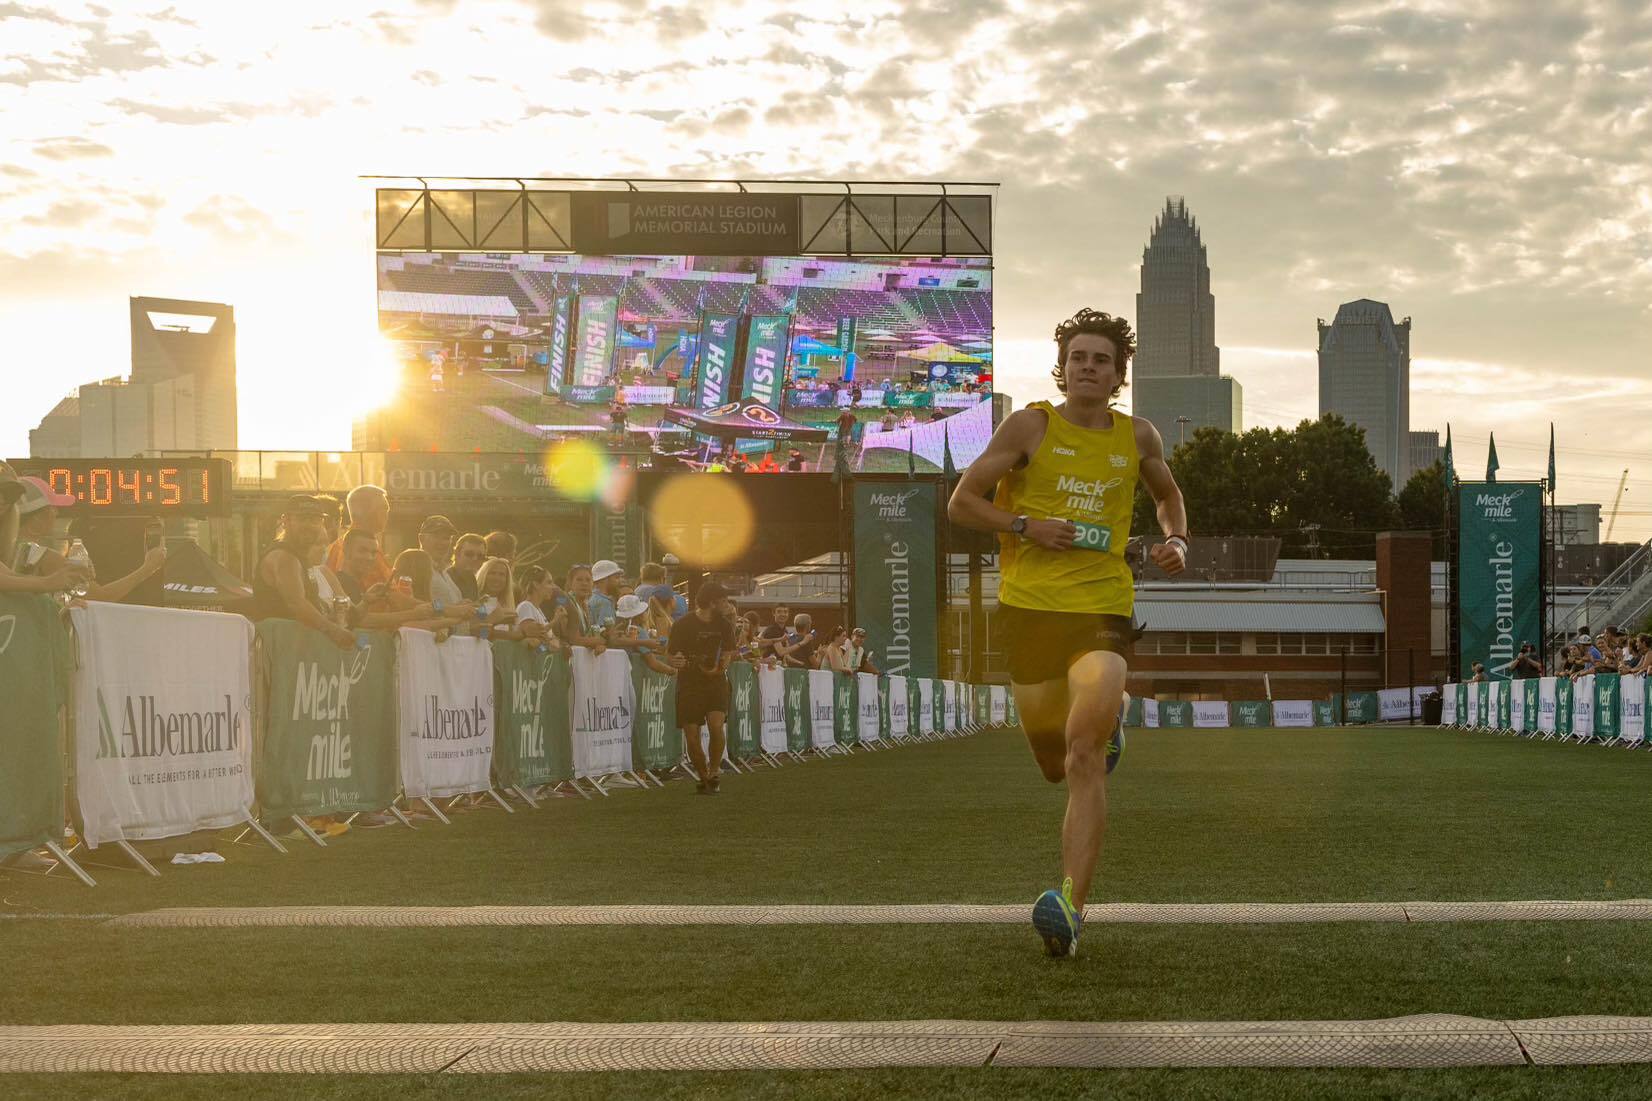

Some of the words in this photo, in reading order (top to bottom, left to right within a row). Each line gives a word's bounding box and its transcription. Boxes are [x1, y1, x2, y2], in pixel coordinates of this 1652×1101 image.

[634, 204, 714, 218] AMERICAN
[719, 206, 776, 219] LEGION
[634, 220, 717, 234] MEMORIAL
[720, 221, 787, 235] STADIUM
[550, 312, 566, 394] FINISH
[582, 319, 607, 386] FINISH
[702, 343, 726, 408] NISH
[1052, 447, 1075, 457] HOKA
[49, 468, 208, 505] 0:04:51
[1056, 475, 1105, 497] Meck
[870, 492, 906, 506] Meck
[1066, 495, 1105, 513] mile
[1476, 493, 1512, 507] Meck
[879, 505, 907, 518] mile
[1485, 505, 1512, 518] mile
[1073, 524, 1110, 547] 907
[885, 540, 910, 677] Albemarle
[1489, 540, 1514, 681] Albemarle
[293, 660, 350, 721] Meck
[1240, 705, 1257, 715] Meck
[121, 694, 240, 759] Albemarle
[306, 720, 352, 781] mile
[144, 773, 155, 785] THE
